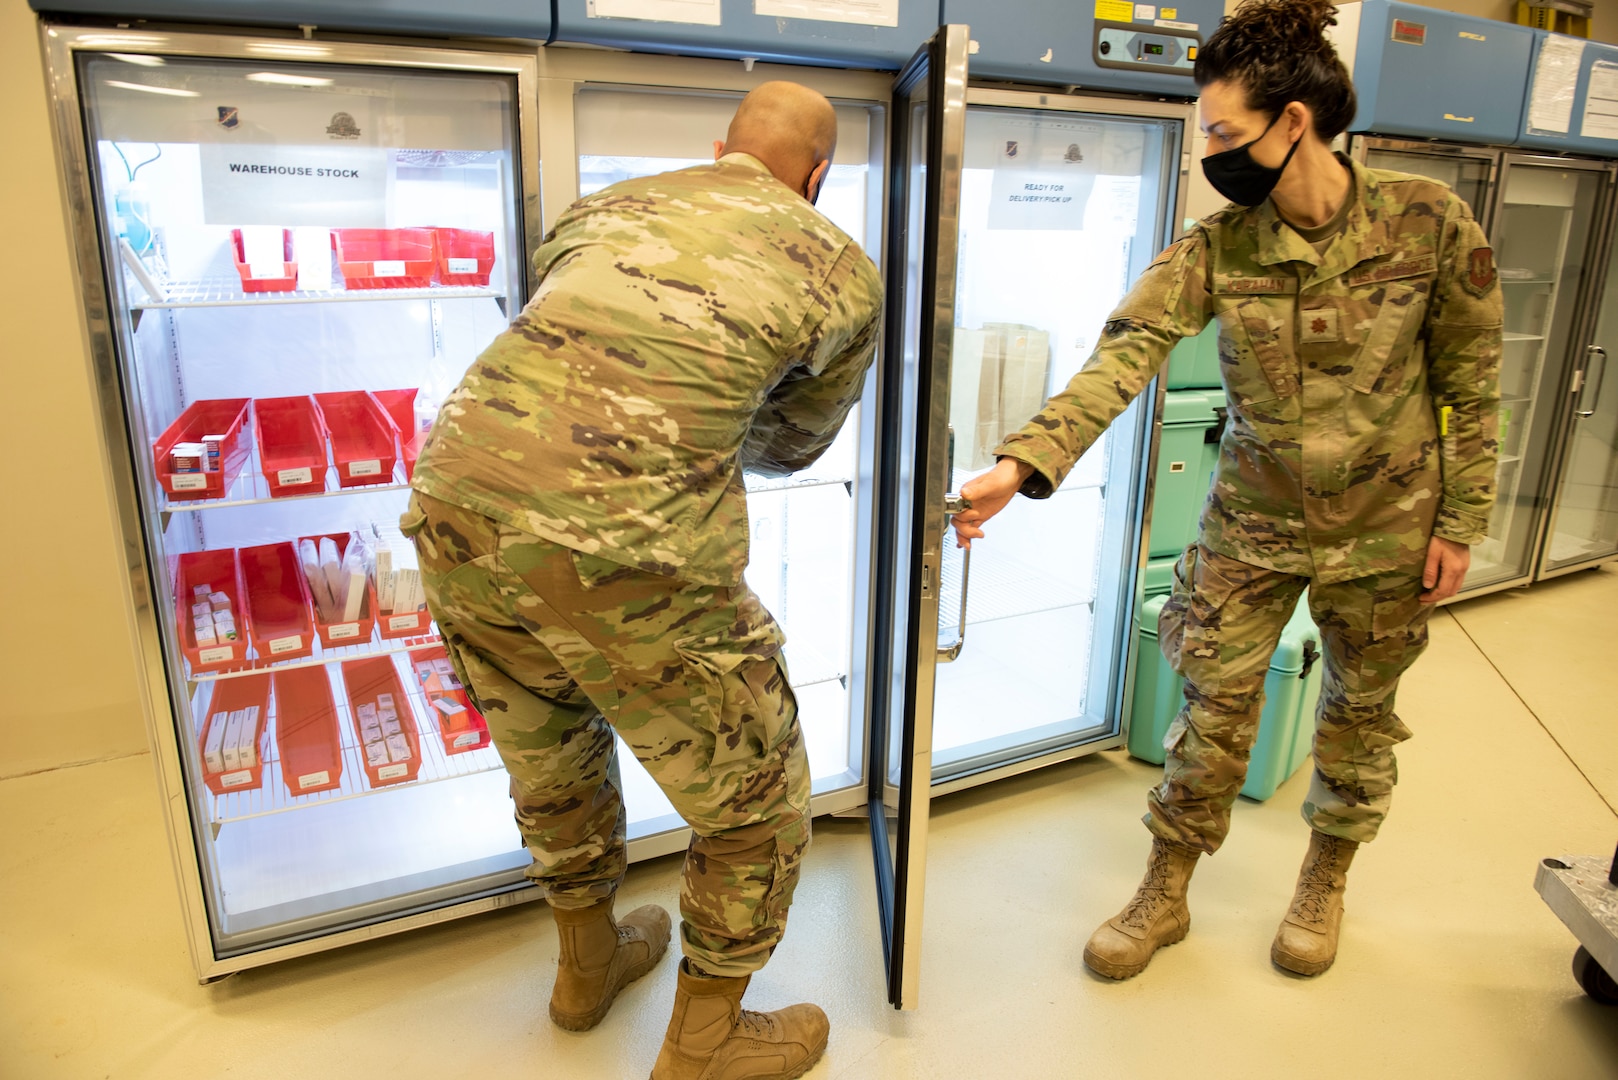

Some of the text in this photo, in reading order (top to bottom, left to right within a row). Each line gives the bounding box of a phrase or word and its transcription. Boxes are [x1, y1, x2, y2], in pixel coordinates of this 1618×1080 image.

[229, 163, 359, 178] WAREHOUSE STOCK
[1024, 183, 1048, 191] READY
